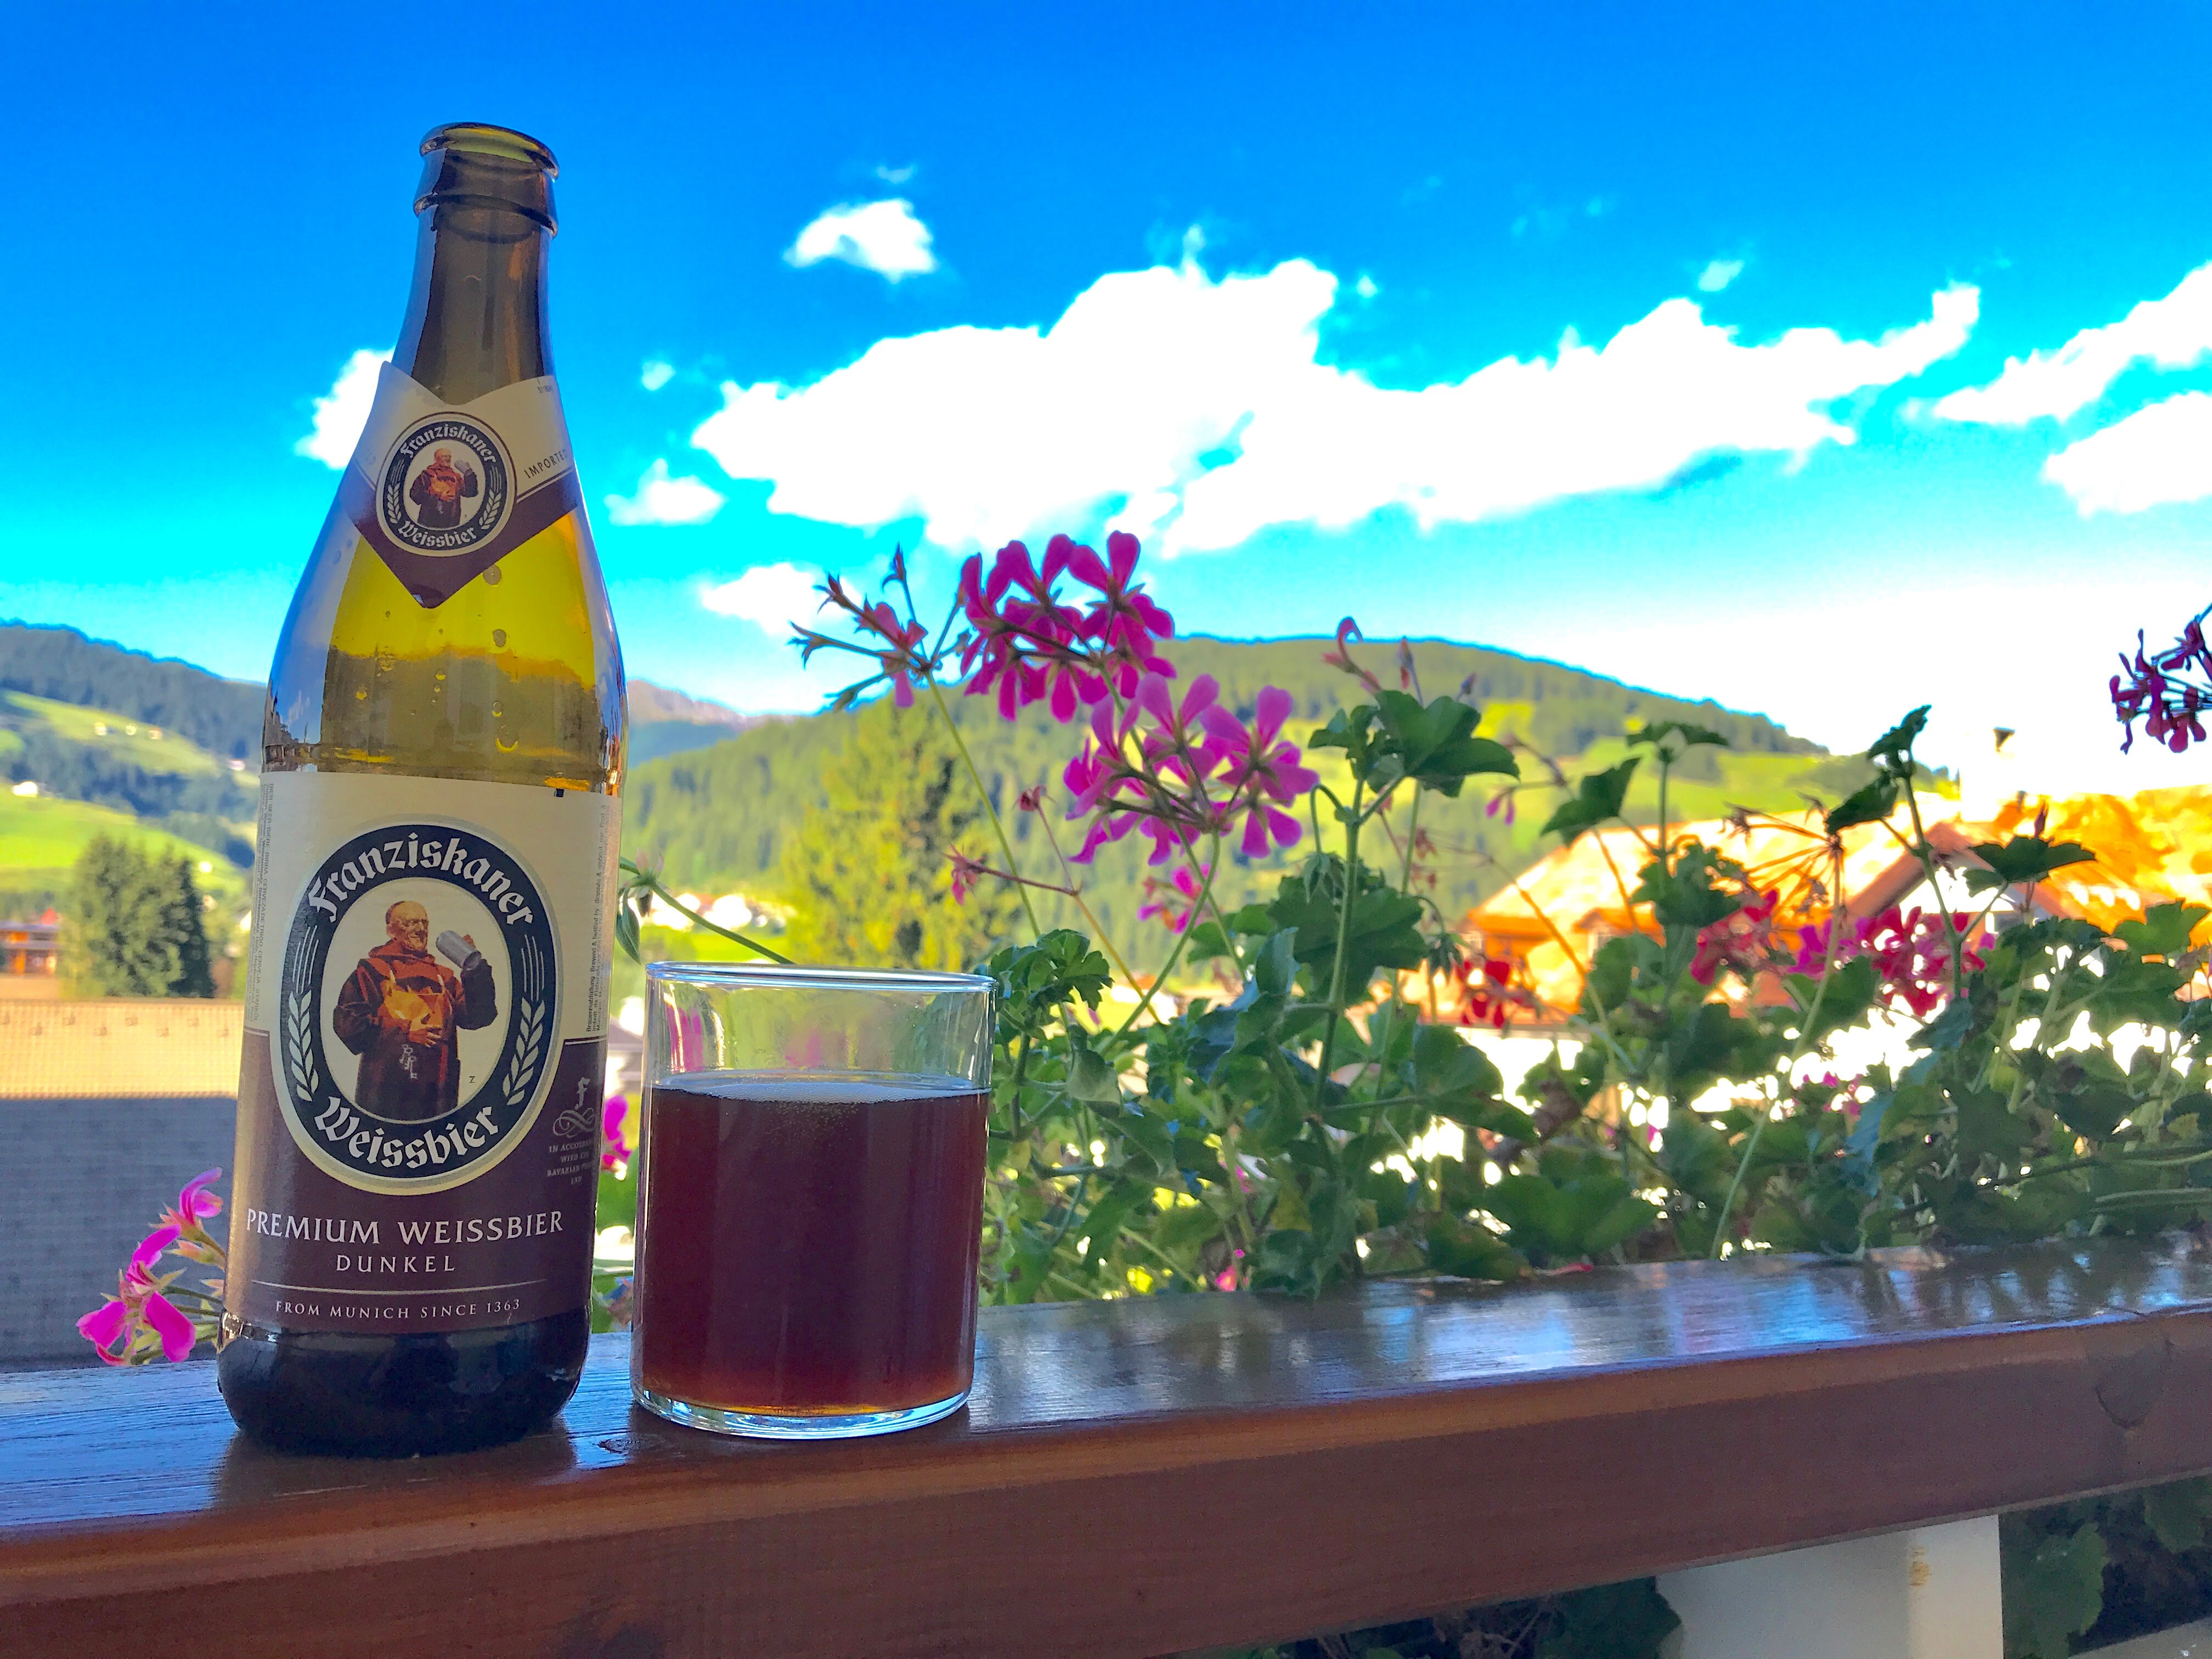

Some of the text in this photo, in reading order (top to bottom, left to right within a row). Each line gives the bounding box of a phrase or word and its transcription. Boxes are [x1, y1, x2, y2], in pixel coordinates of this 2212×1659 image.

[400, 424, 496, 464] Franziskaner
[523, 449, 568, 479] IMPORTED
[398, 520, 477, 548] Weissbier
[307, 832, 533, 925] Franziskaner
[314, 1096, 499, 1169] Weissbier
[246, 1207, 563, 1246] PREMIUM WEISSBIER
[336, 1254, 456, 1273] DUNKEL
[275, 1299, 521, 1319] FROM MUNICH SINCE 1363
